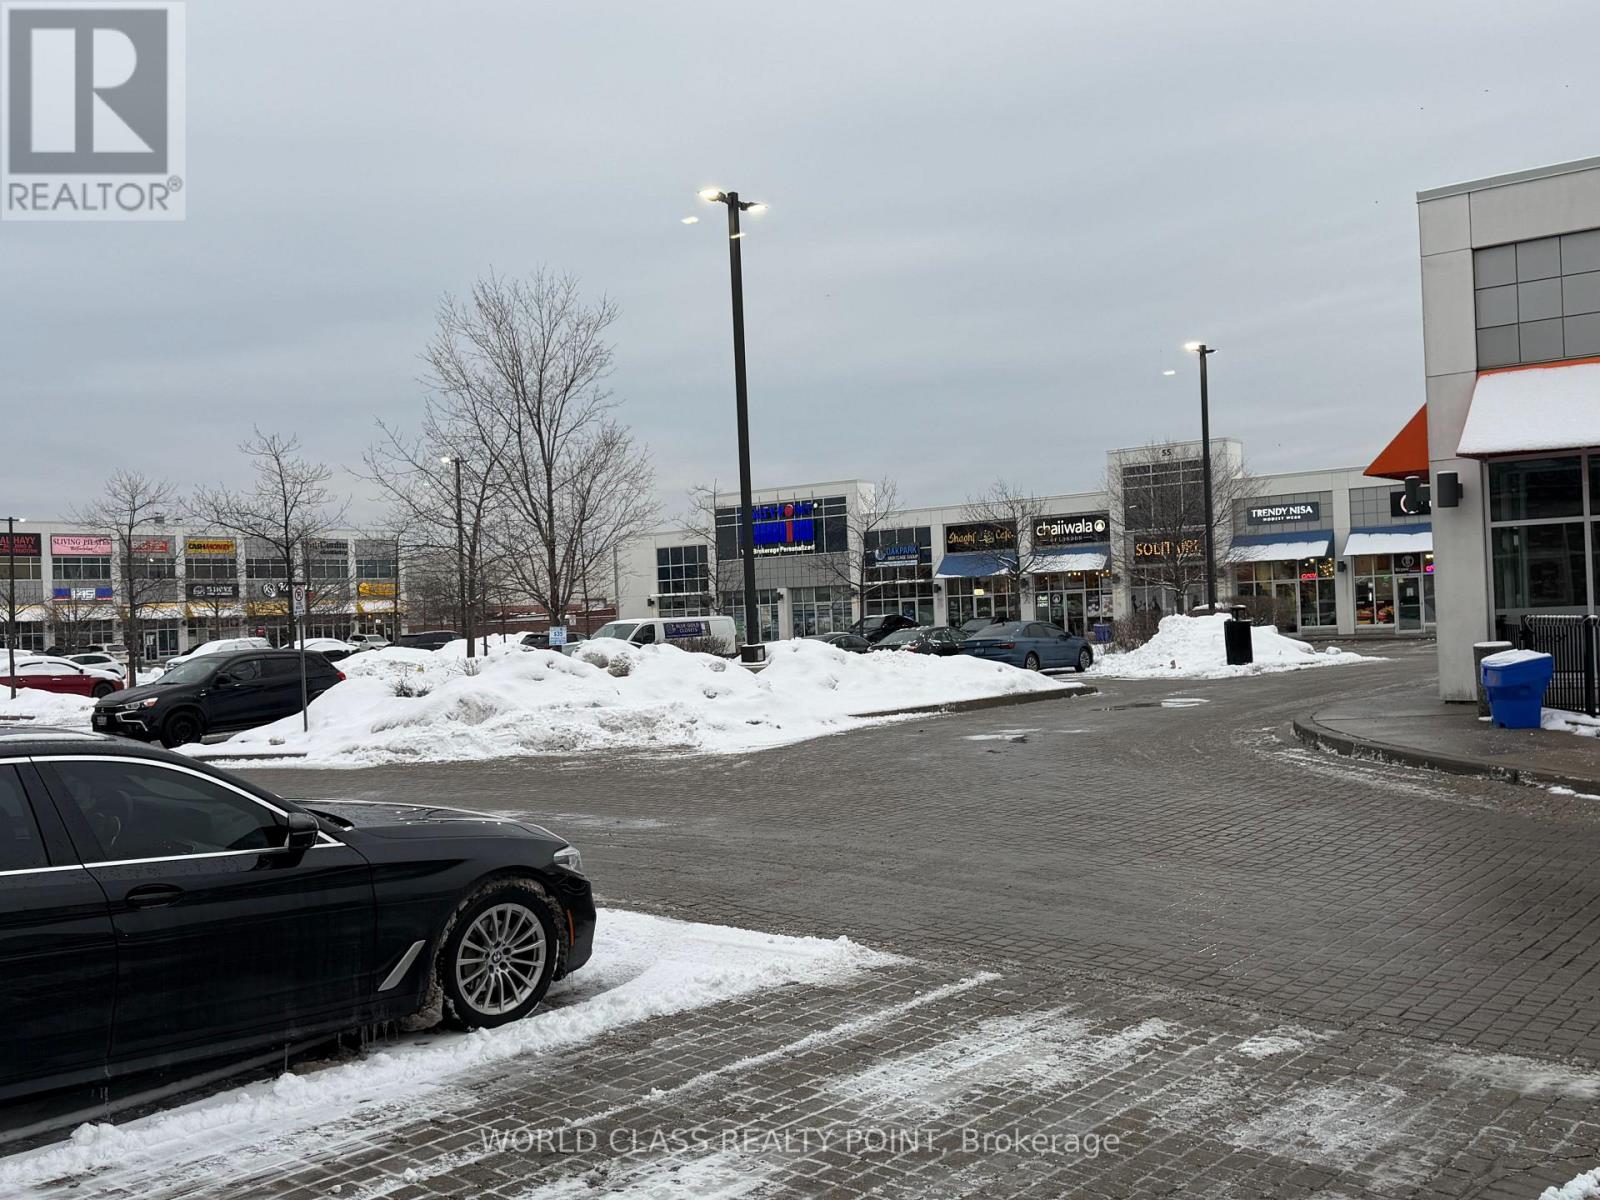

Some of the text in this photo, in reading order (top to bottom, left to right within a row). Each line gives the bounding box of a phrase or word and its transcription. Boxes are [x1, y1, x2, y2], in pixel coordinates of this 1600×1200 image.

[1251, 505, 1313, 518] TRENDY NISA
[1036, 518, 1093, 536] chaiiwala
[52, 538, 81, 546] SLIVING
[947, 531, 977, 544] Shaghf
[753, 543, 816, 556] Brokerage Personalized
